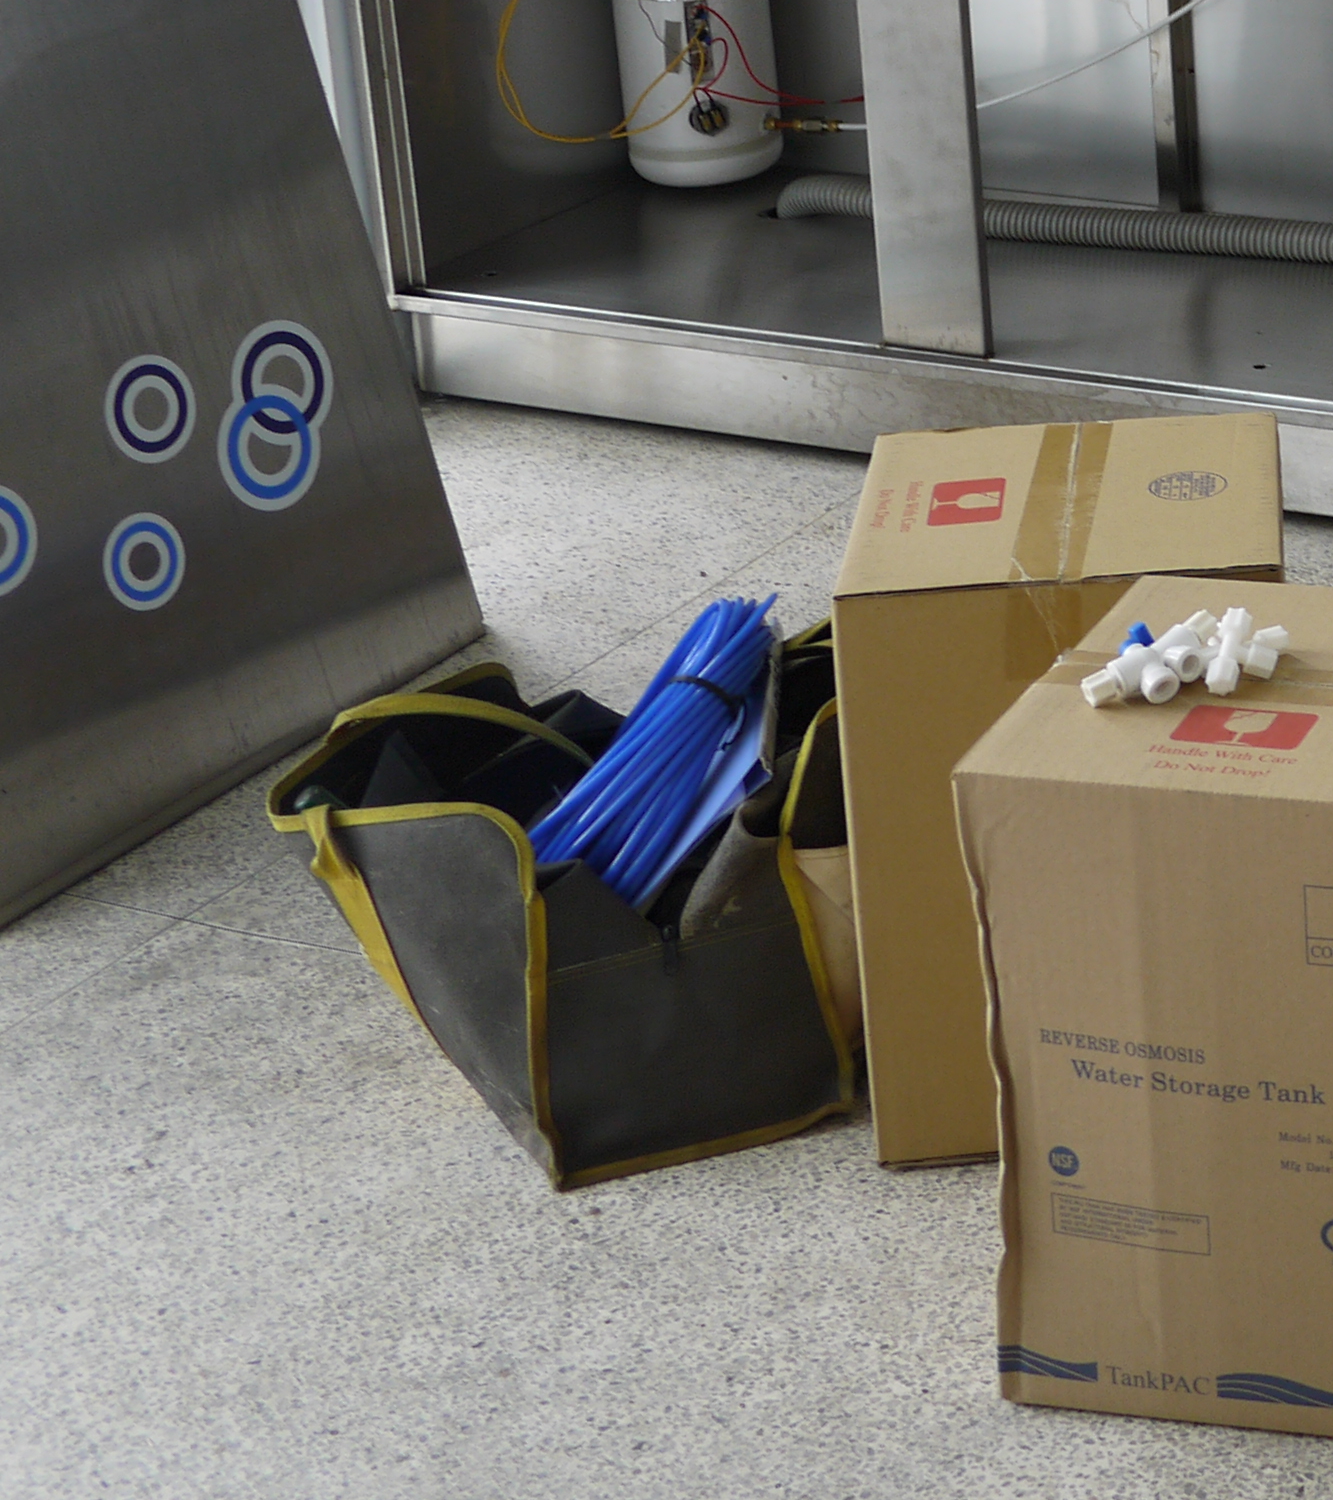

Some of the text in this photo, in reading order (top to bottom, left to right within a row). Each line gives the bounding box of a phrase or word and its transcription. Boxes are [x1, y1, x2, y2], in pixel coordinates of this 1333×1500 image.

[1149, 744, 1299, 765] Handle With Care
[1154, 760, 1272, 778] Do Not Drop!
[1039, 1028, 1206, 1065] REVERSE OSMOSIS
[1071, 1058, 1326, 1105] Water Storage Tank
[1278, 1131, 1312, 1144] Model
[1051, 1152, 1075, 1169] NSF
[1105, 1364, 1211, 1397] TankPAC
